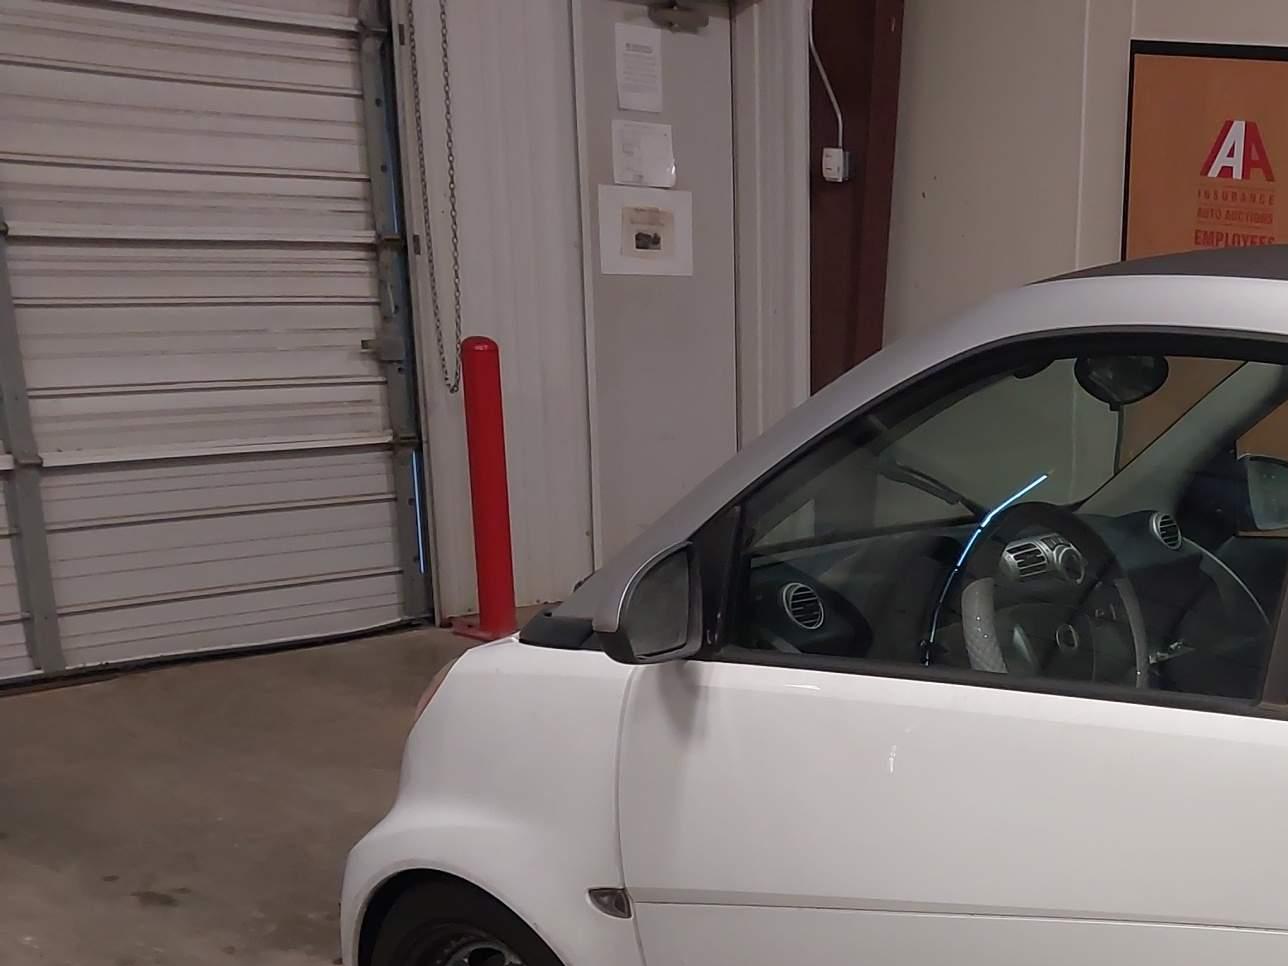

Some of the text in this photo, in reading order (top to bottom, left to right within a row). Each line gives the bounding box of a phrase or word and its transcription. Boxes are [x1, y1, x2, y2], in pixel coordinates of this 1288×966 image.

[1198, 189, 1275, 206] INSURANCE
[1197, 207, 1273, 225] AUTO AUCTIONS
[1194, 229, 1275, 247] EMPLOYEES
